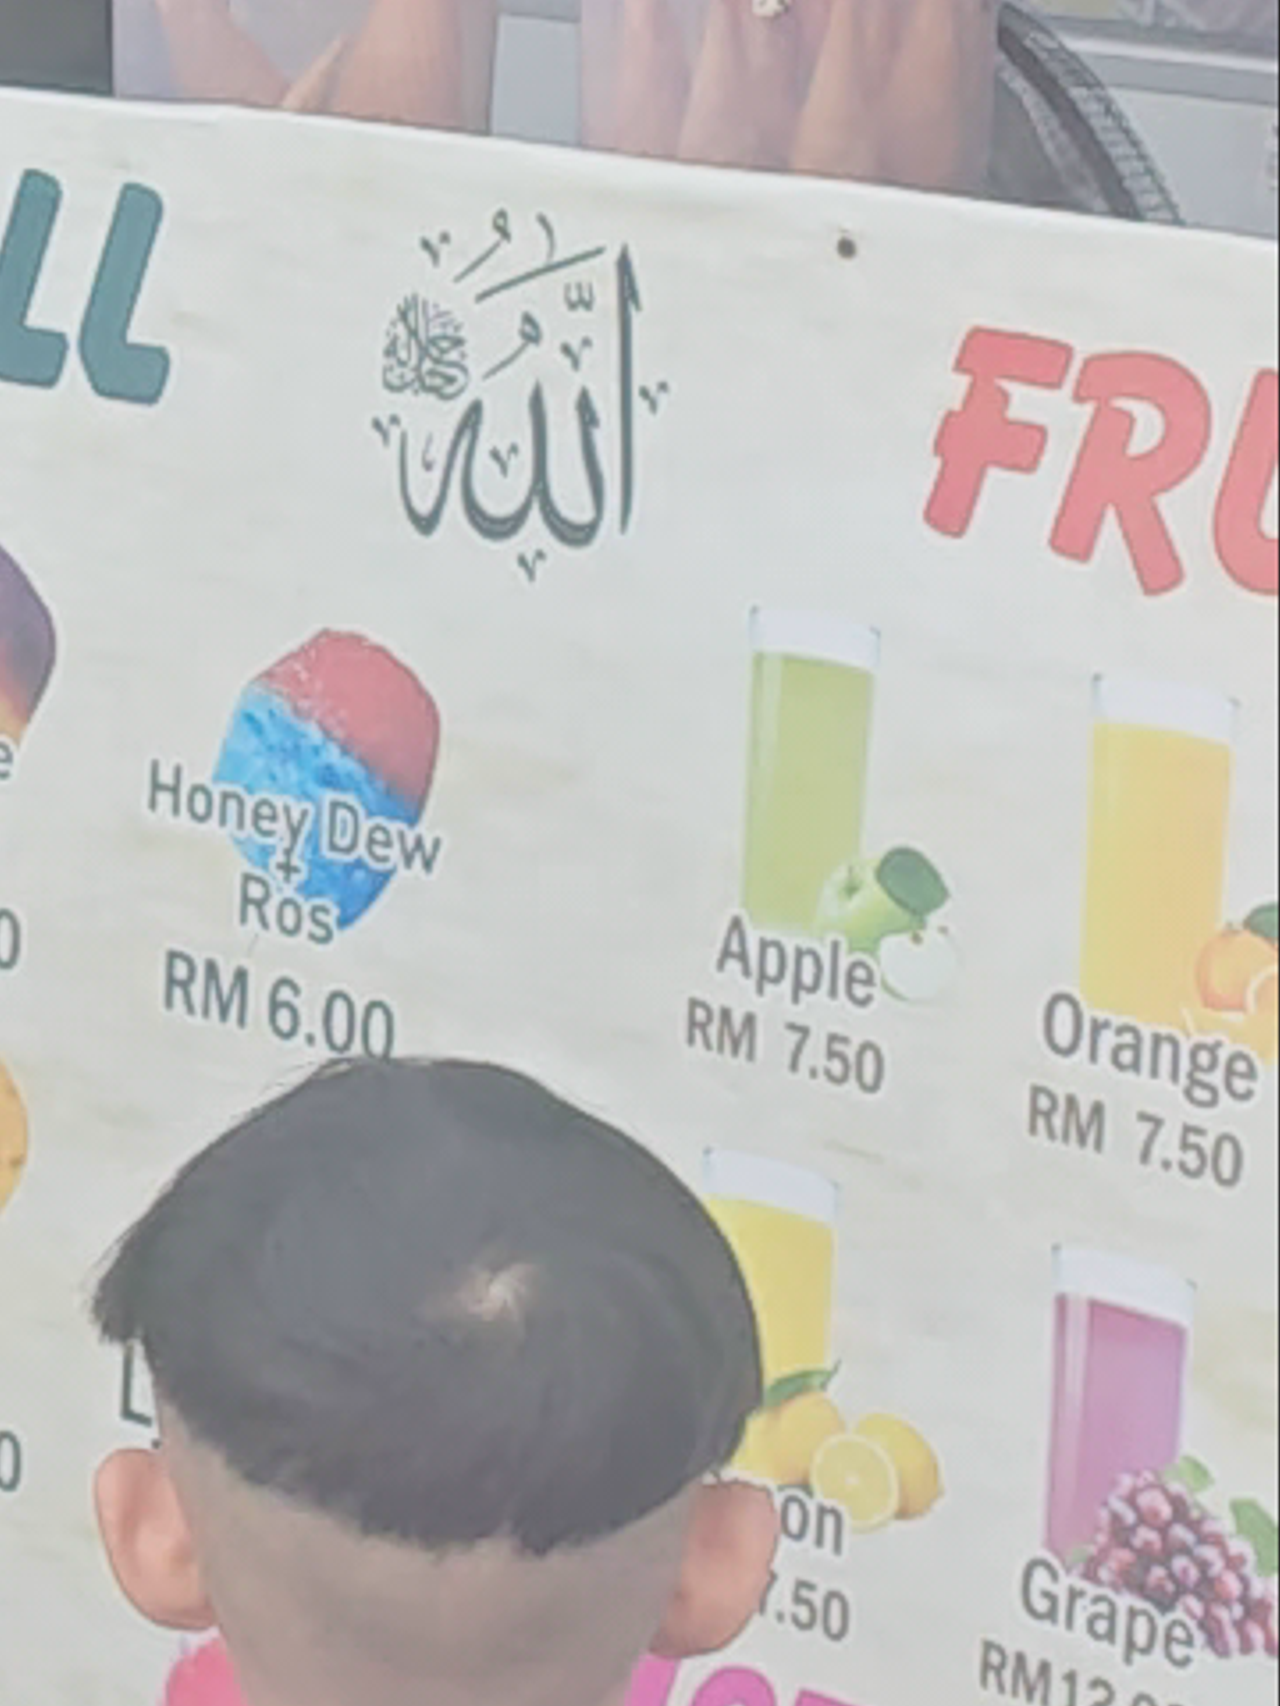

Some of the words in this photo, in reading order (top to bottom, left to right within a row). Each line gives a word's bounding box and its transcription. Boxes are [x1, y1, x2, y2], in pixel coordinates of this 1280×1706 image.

[148, 759, 309, 853] Honey
[326, 798, 441, 873] Dew
[238, 870, 337, 943] Ros
[163, 950, 250, 1029] RM
[267, 975, 397, 1060] 6.00
[715, 915, 879, 1007] Apple
[685, 997, 758, 1063] RM
[782, 1023, 886, 1095] 7.50
[1042, 993, 1260, 1103] Orange
[1026, 1084, 1106, 1155] RM
[1135, 1112, 1244, 1188] 7.50
[1020, 1555, 1196, 1670] Grape
